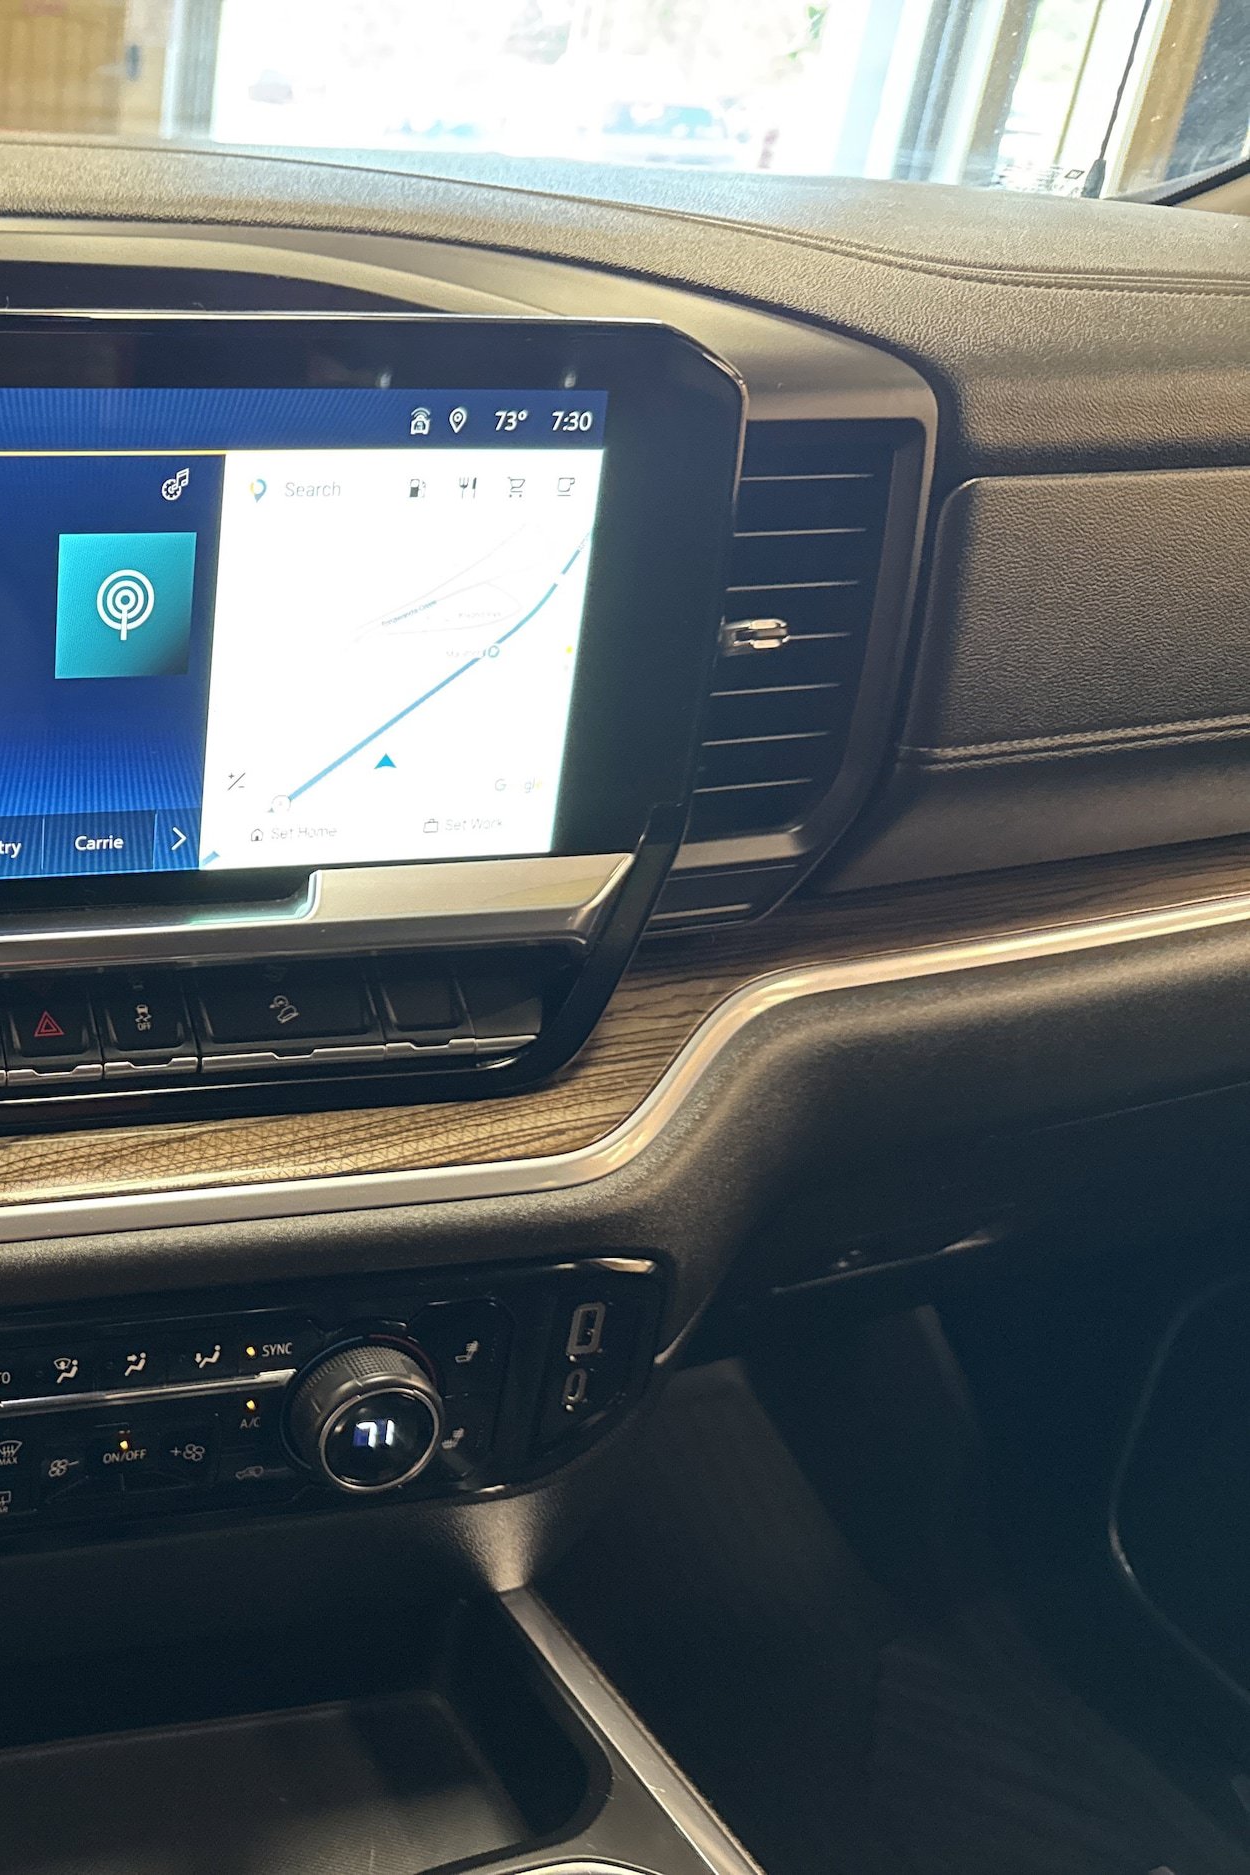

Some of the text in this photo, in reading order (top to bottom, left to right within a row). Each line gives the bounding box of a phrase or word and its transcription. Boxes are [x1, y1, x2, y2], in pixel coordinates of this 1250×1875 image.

[494, 409, 529, 432] 73°
[551, 411, 593, 432] 7:30
[285, 481, 342, 498] Search
[445, 818, 503, 831] Set Work
[271, 827, 338, 840] Set Home
[75, 836, 124, 851] Carrie
[137, 1022, 152, 1031] OFF
[262, 1342, 293, 1358] SYNC
[240, 1416, 261, 1429] A/C
[357, 1419, 395, 1448] 71
[103, 1449, 147, 1465] ON/OFF
